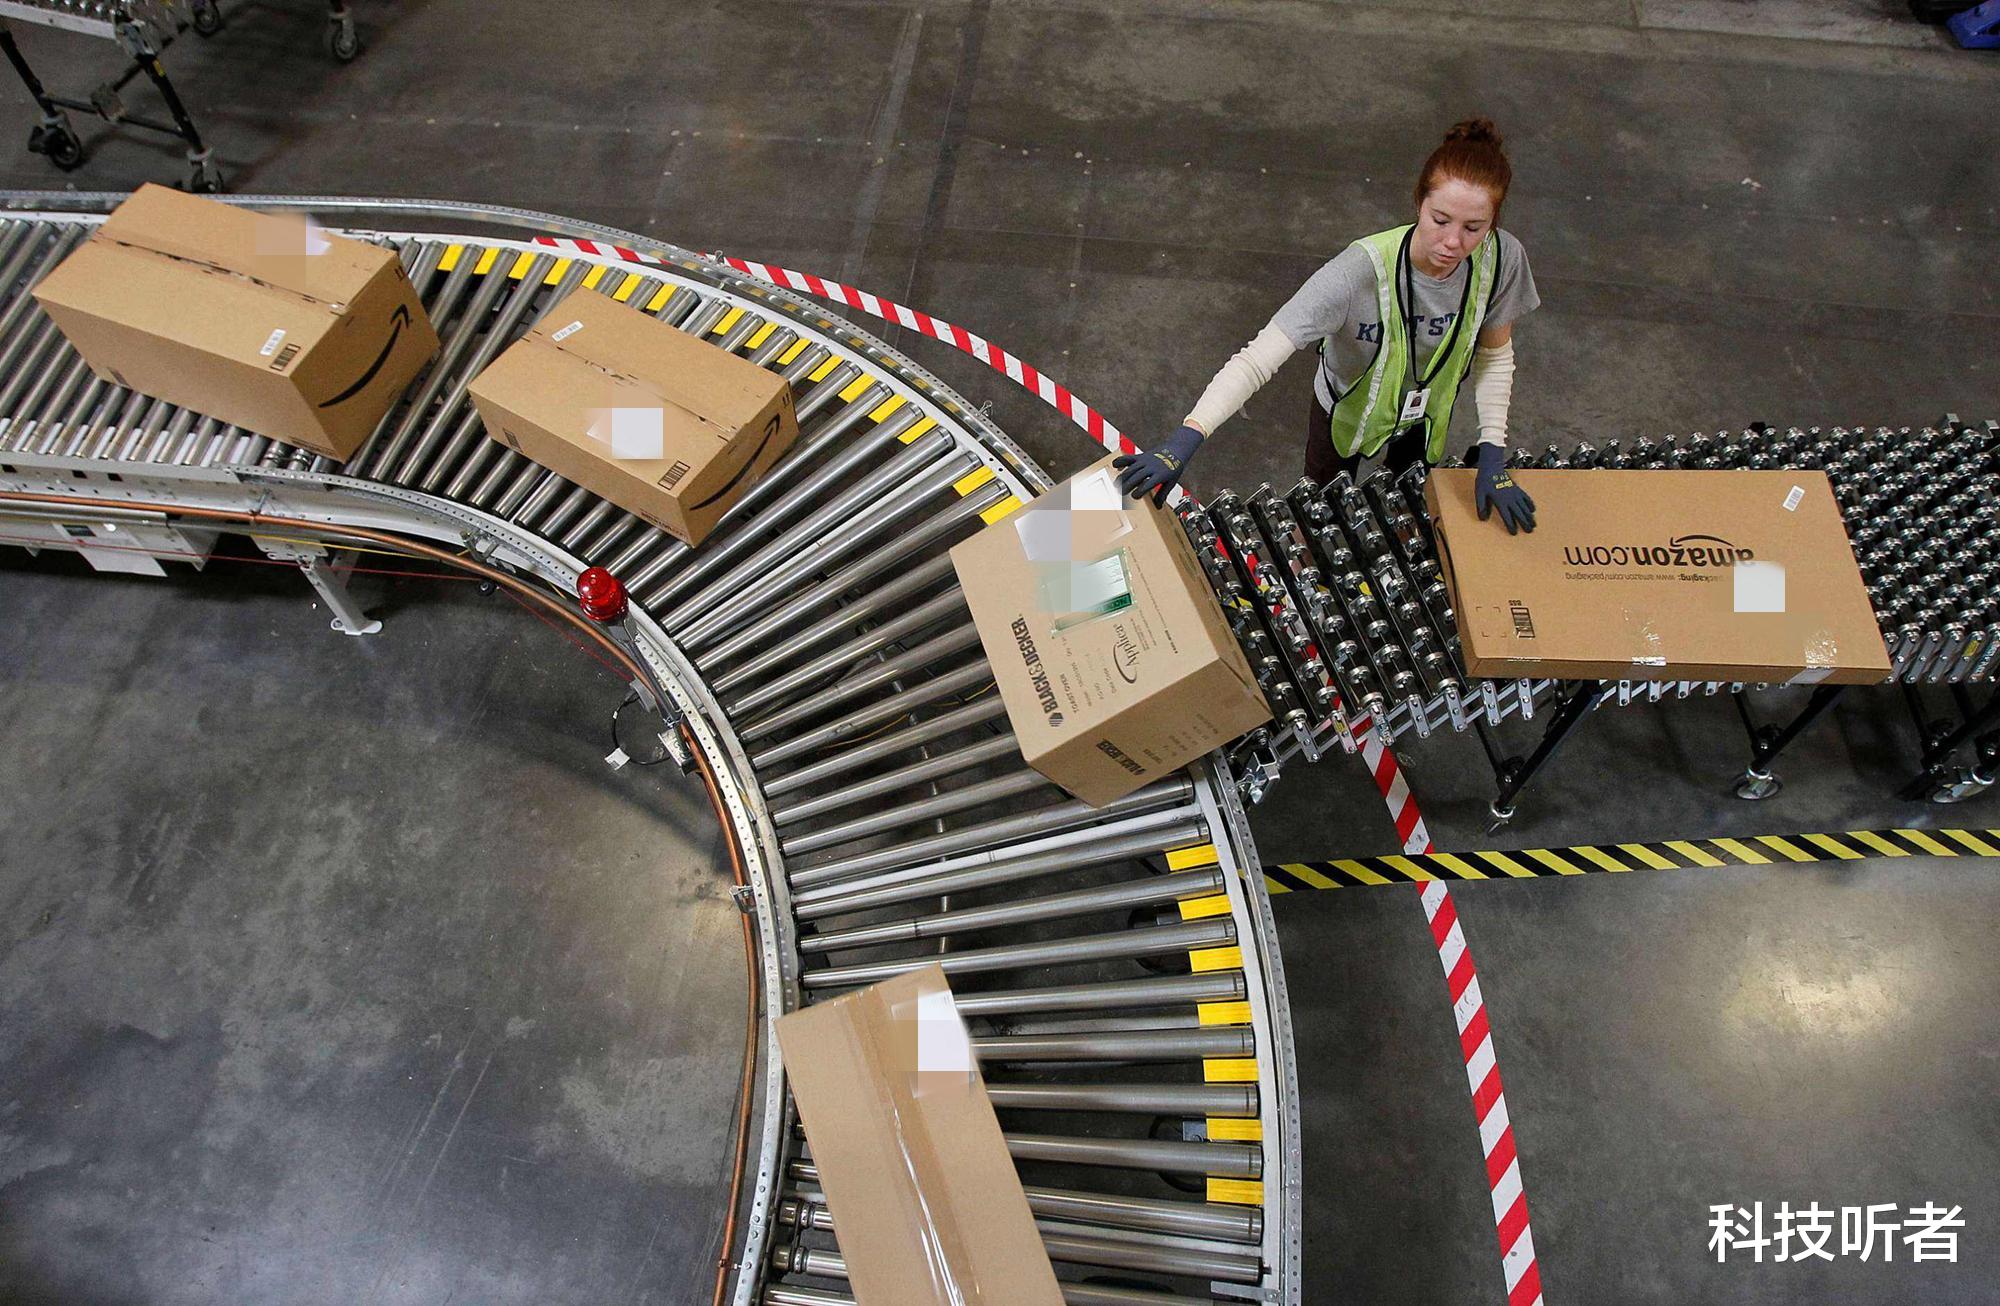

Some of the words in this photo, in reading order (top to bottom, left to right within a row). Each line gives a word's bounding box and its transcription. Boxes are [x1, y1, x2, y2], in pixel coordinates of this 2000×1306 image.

[1563, 545, 1754, 568] amazon.com
[1011, 616, 1059, 714] BLACK&DECKER
[1115, 625, 1140, 667] Applica
